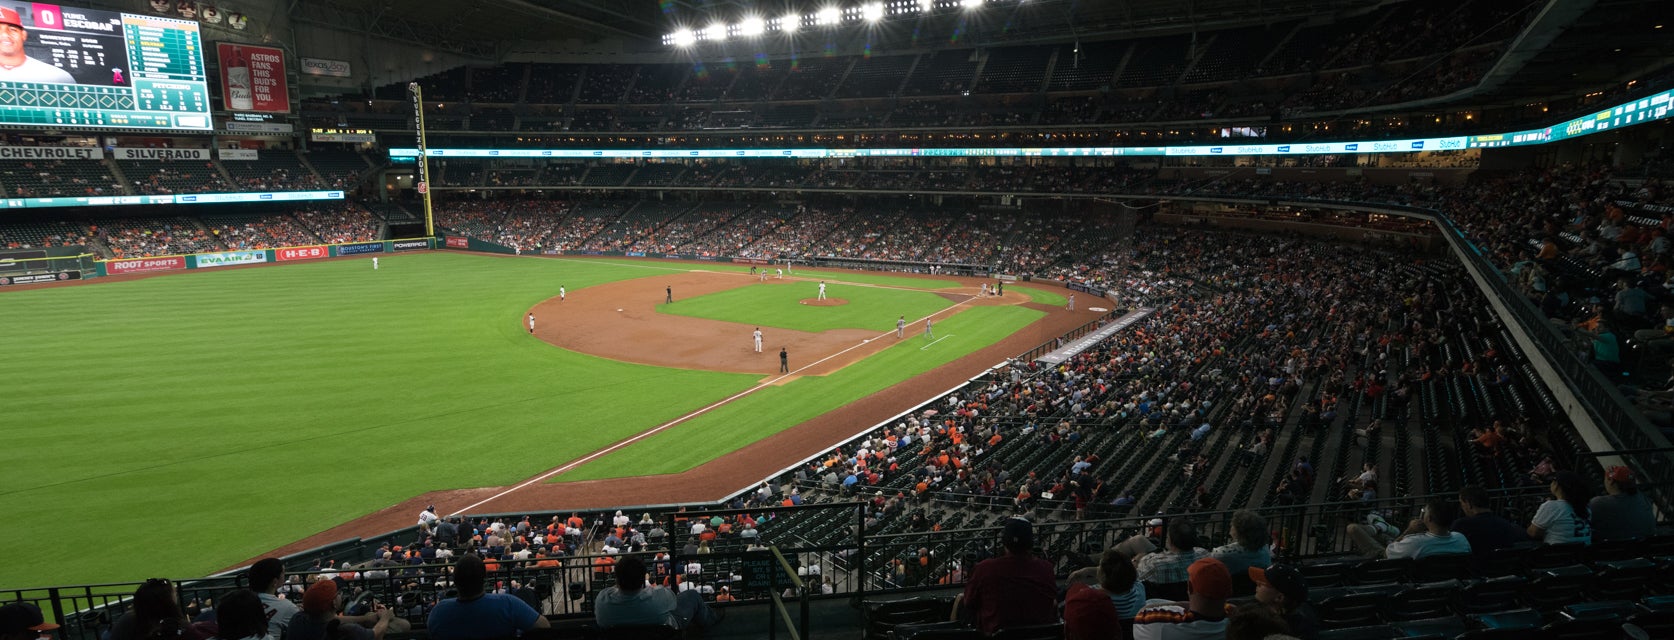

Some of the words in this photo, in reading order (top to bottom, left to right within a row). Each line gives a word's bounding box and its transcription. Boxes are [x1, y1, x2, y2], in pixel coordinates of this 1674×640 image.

[41, 10, 54, 25] 0
[63, 19, 113, 31] ESCOBAR
[251, 53, 280, 63] ASTROS
[251, 61, 273, 71] FANS,
[253, 70, 270, 78] THIS
[254, 77, 277, 86] BUD'S
[255, 85, 270, 93] FOR
[255, 93, 274, 102] YOU.
[1373, 142, 1398, 151] StubHub
[1439, 139, 1461, 148] StubHub
[1, 148, 93, 159] CHEVROLET
[127, 149, 201, 159] SILVERADO
[114, 260, 143, 270] ROOT
[144, 259, 178, 267] SPORTS
